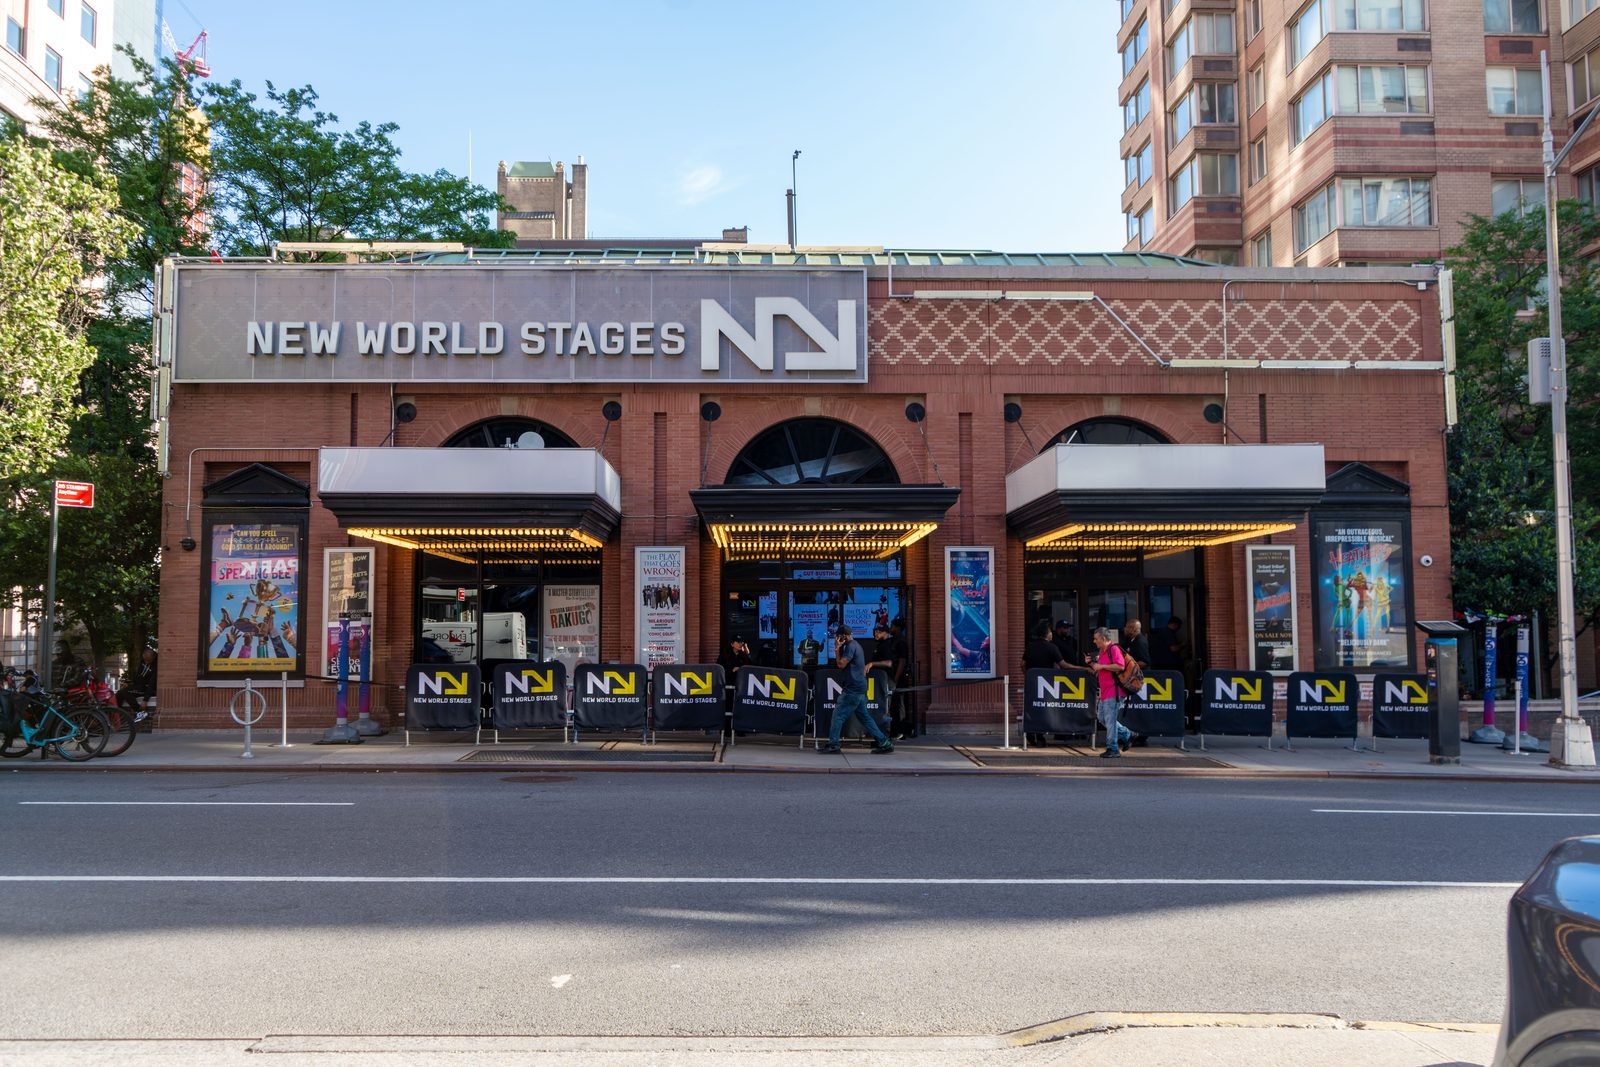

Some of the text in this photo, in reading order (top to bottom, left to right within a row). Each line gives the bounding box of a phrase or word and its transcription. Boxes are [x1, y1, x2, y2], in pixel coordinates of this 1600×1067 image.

[246, 320, 686, 356] NEW WORLD STAGES
[1325, 535, 1367, 543] IRREPRESSIBLE
[254, 543, 263, 551] ALL
[659, 560, 680, 568] GOES
[643, 567, 680, 577] WRONG
[550, 609, 593, 629] RAKUGO
[755, 699, 776, 707] WORLD
[776, 701, 798, 710] STAGES
